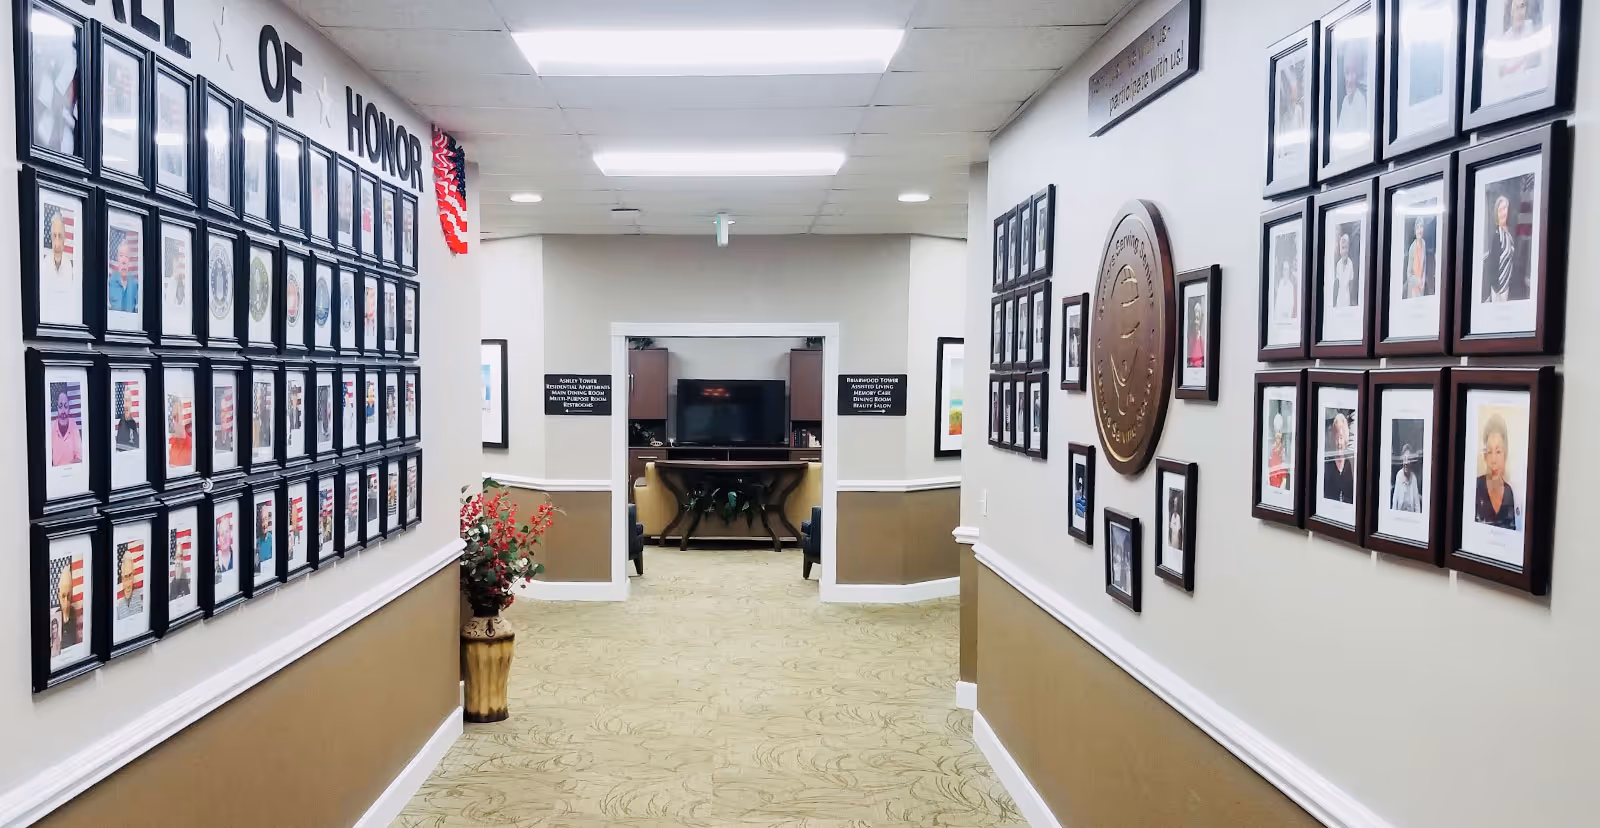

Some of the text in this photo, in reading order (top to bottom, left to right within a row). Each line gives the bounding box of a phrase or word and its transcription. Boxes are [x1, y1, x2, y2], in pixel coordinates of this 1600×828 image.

[258, 24, 302, 118] OF
[345, 85, 424, 193] HONOR
[1109, 71, 1149, 117] participate
[1151, 55, 1168, 83] with
[1170, 39, 1184, 70] us!
[1115, 230, 1140, 257] Serving
